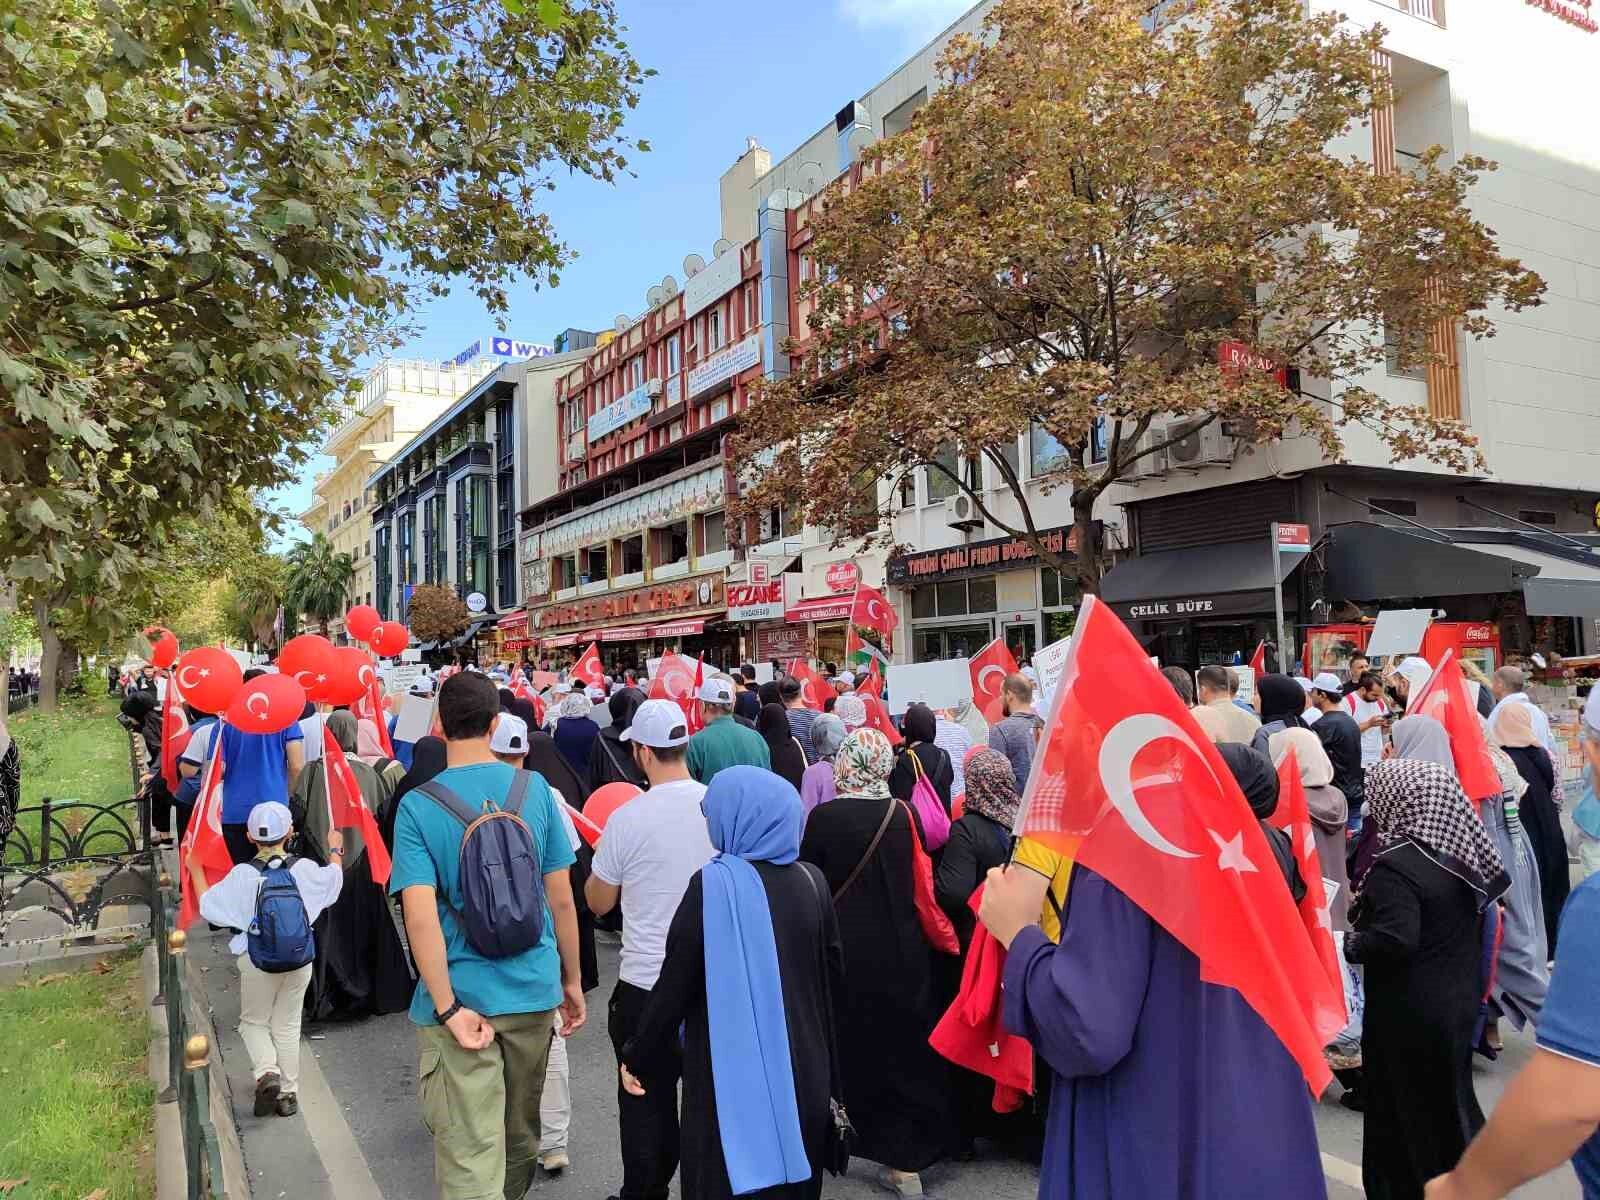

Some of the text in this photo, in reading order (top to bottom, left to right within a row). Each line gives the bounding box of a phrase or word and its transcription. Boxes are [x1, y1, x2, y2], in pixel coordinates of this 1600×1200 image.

[727, 581, 782, 608] ECZANE
[1129, 600, 1213, 618] ÇELİK BÜFE
